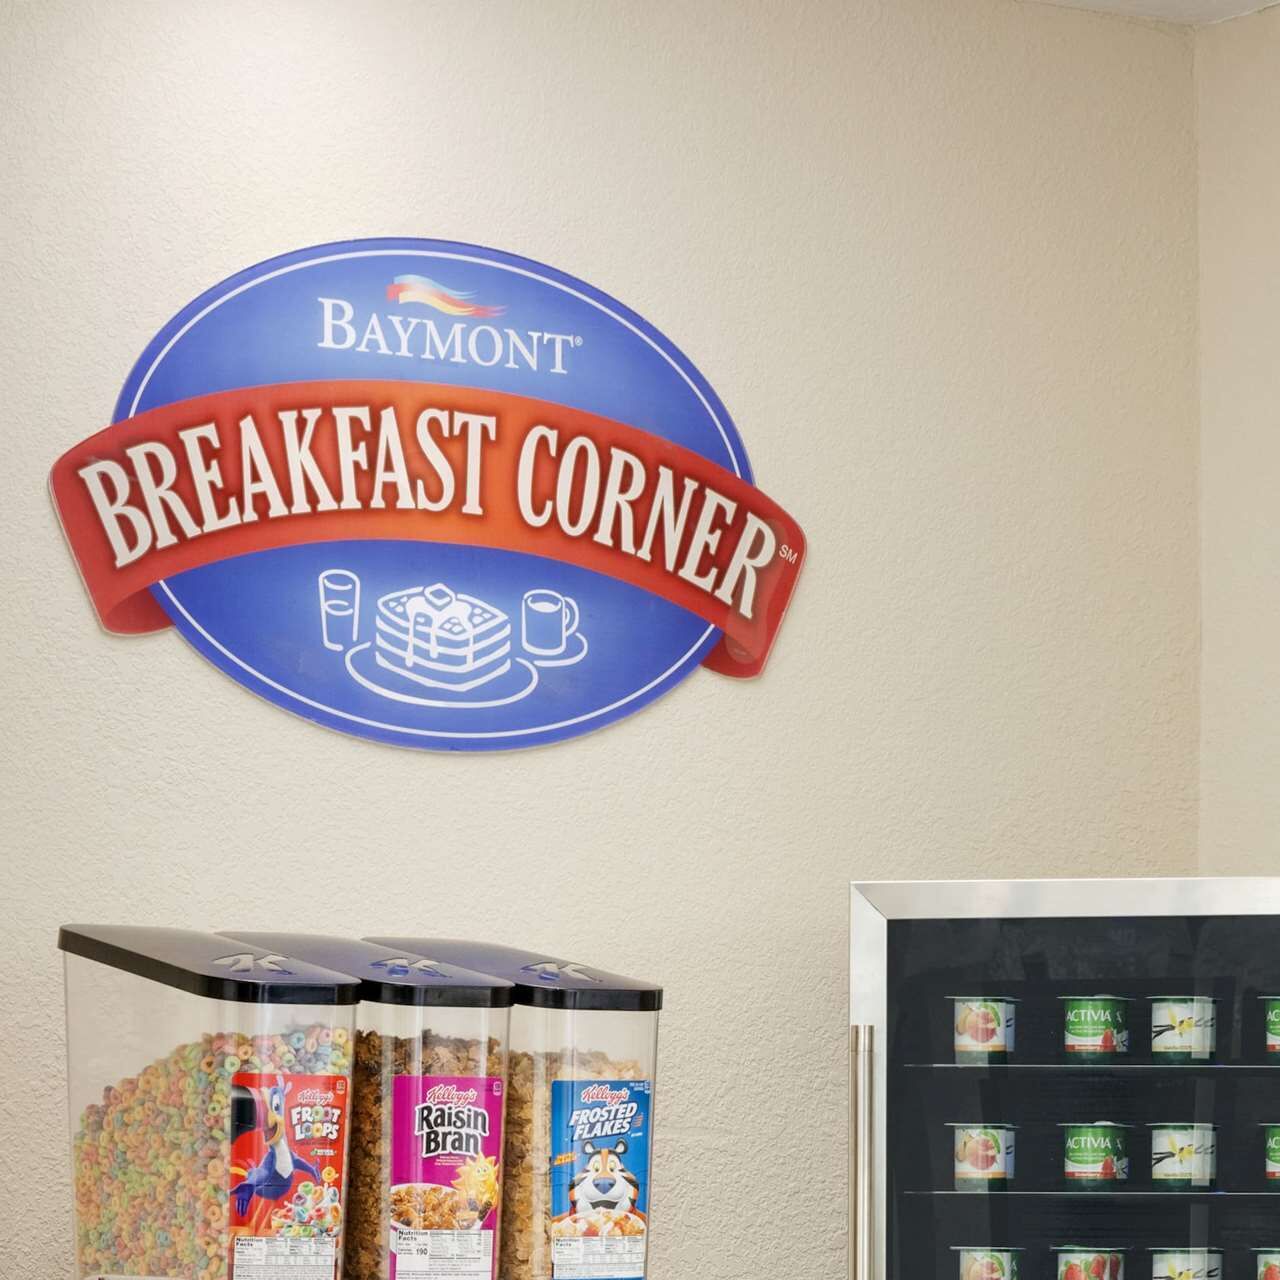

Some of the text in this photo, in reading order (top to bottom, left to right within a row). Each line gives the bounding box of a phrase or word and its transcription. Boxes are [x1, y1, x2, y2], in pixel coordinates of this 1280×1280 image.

[78, 406, 497, 569] BREAKFAST
[517, 425, 777, 620] CORNER
[426, 1084, 478, 1106] Kellogg's
[581, 1084, 630, 1107] Kellogg's
[290, 1105, 342, 1125] FROOT
[415, 1103, 489, 1136] Raisin
[569, 1102, 638, 1127] FROSTED
[294, 1122, 340, 1141] LOOPS
[573, 1117, 632, 1141] FLAKES
[422, 1129, 481, 1158] Bran
